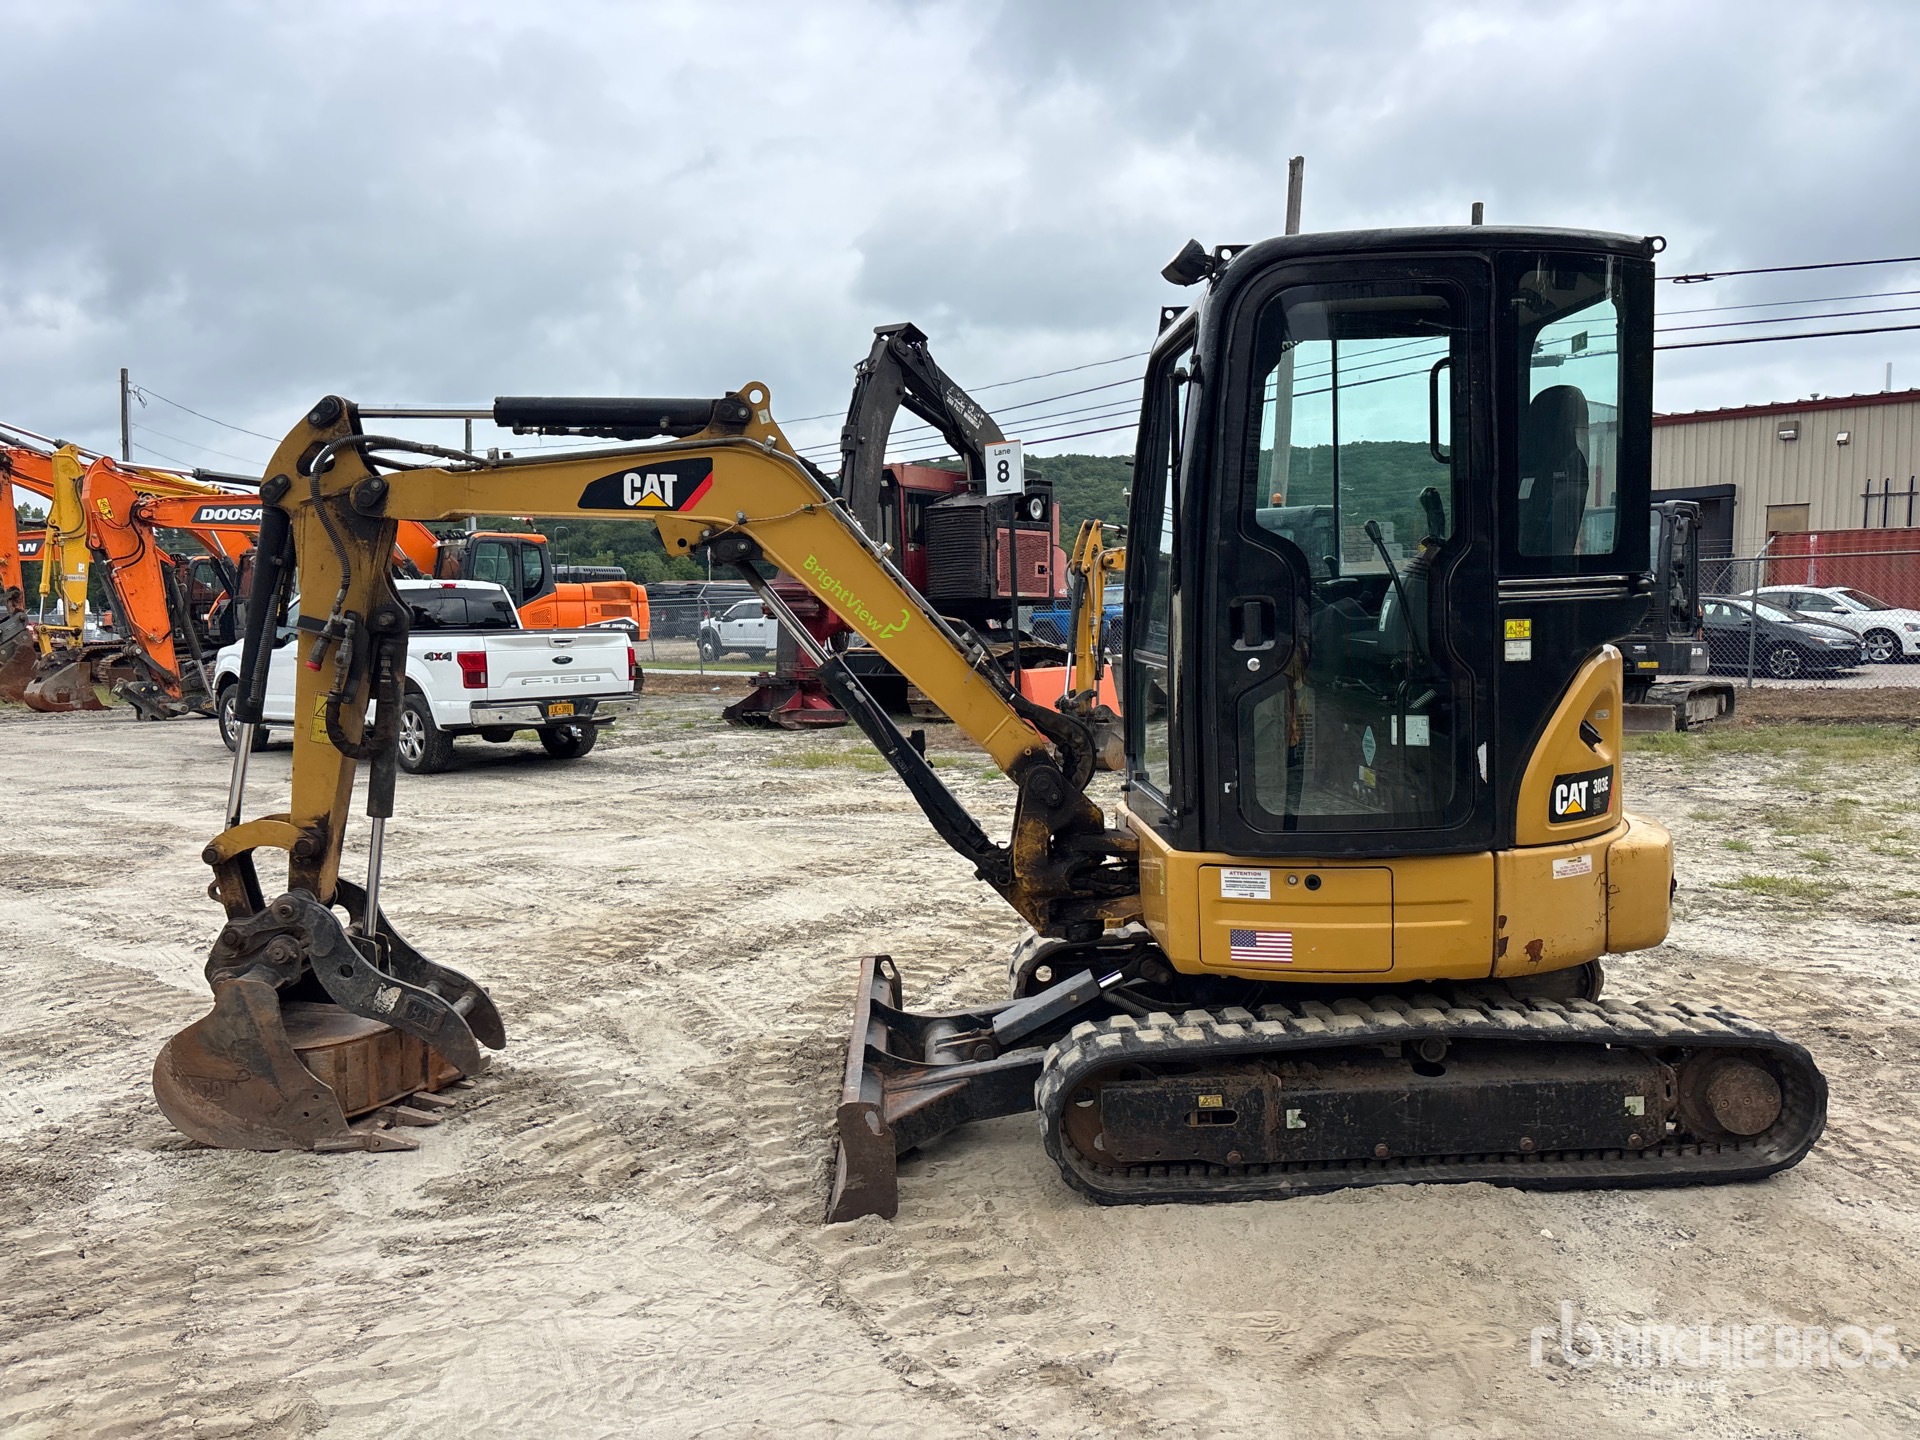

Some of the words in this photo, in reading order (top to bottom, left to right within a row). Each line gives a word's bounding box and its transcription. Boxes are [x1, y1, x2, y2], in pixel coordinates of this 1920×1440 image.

[994, 448, 1011, 456] Lane
[997, 459, 1010, 483] 8
[623, 472, 678, 508] CAT
[802, 554, 883, 632] BrightView
[521, 675, 600, 685] F-150
[1555, 781, 1589, 816] CAT
[1592, 776, 1609, 795] 303E
